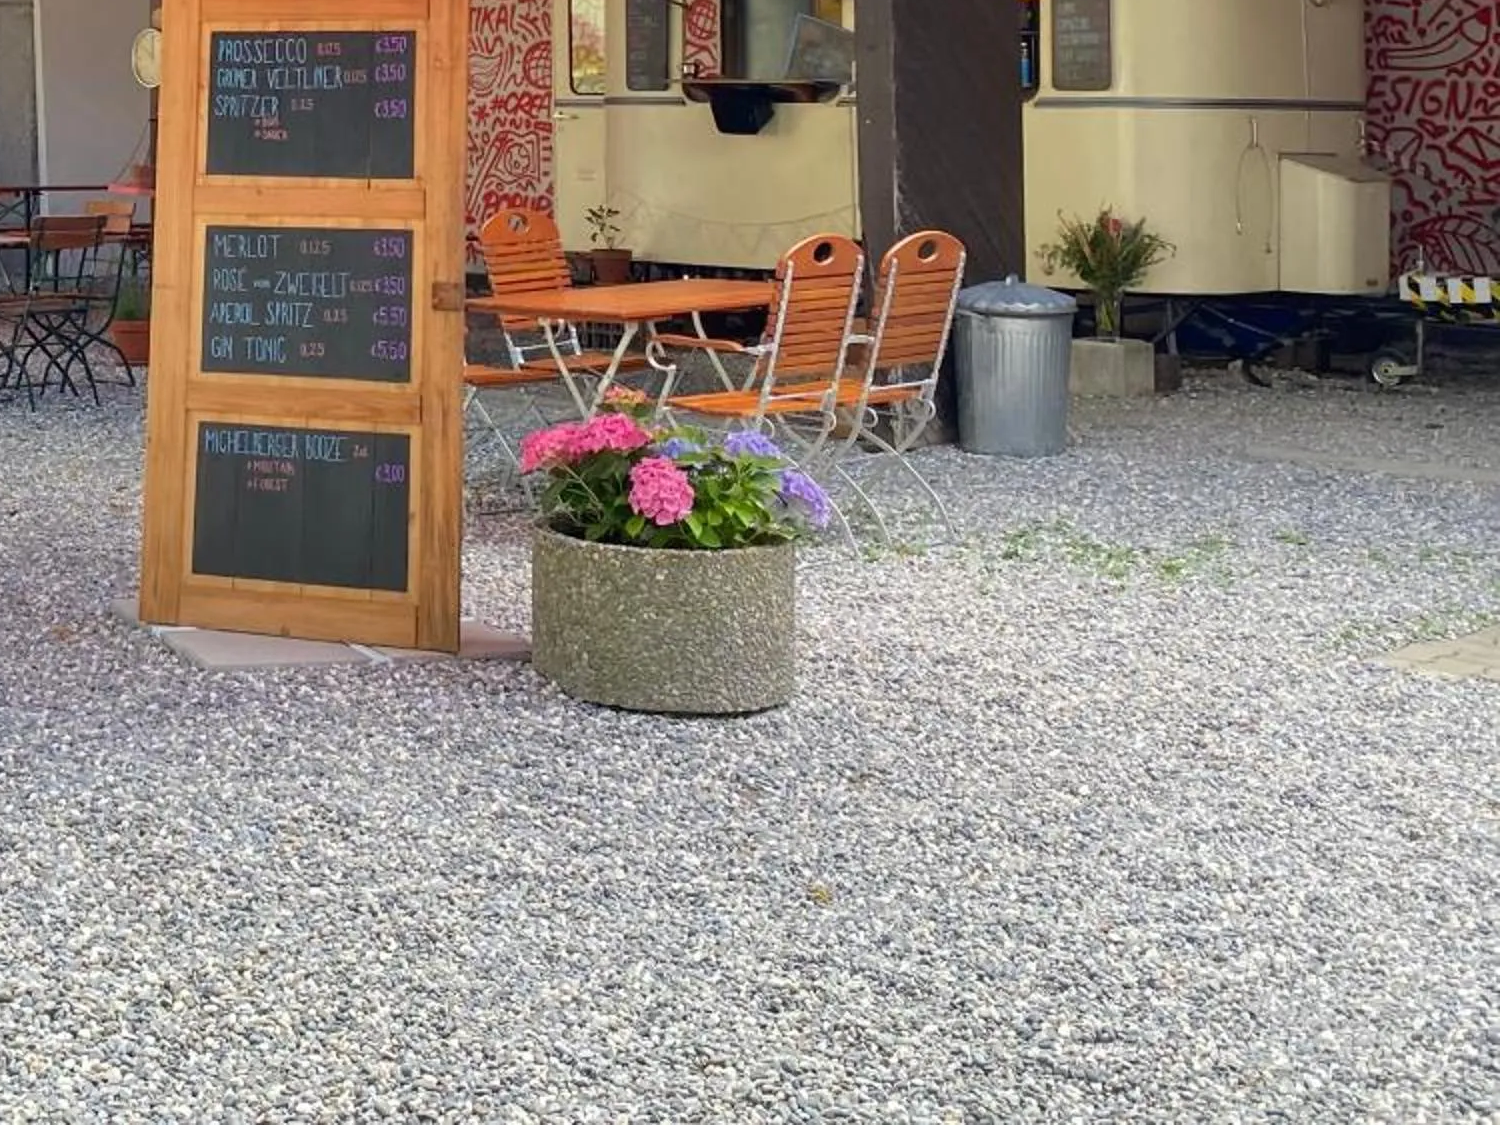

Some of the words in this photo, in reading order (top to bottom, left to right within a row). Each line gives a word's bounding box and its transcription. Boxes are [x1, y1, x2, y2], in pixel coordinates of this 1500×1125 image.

[214, 234, 281, 258] MERLOT
[209, 302, 260, 326] APEROL
[265, 302, 314, 328] SPRITZ
[211, 337, 234, 359] GIN
[245, 336, 286, 363] TONIC
[305, 436, 349, 462] BOOZE
